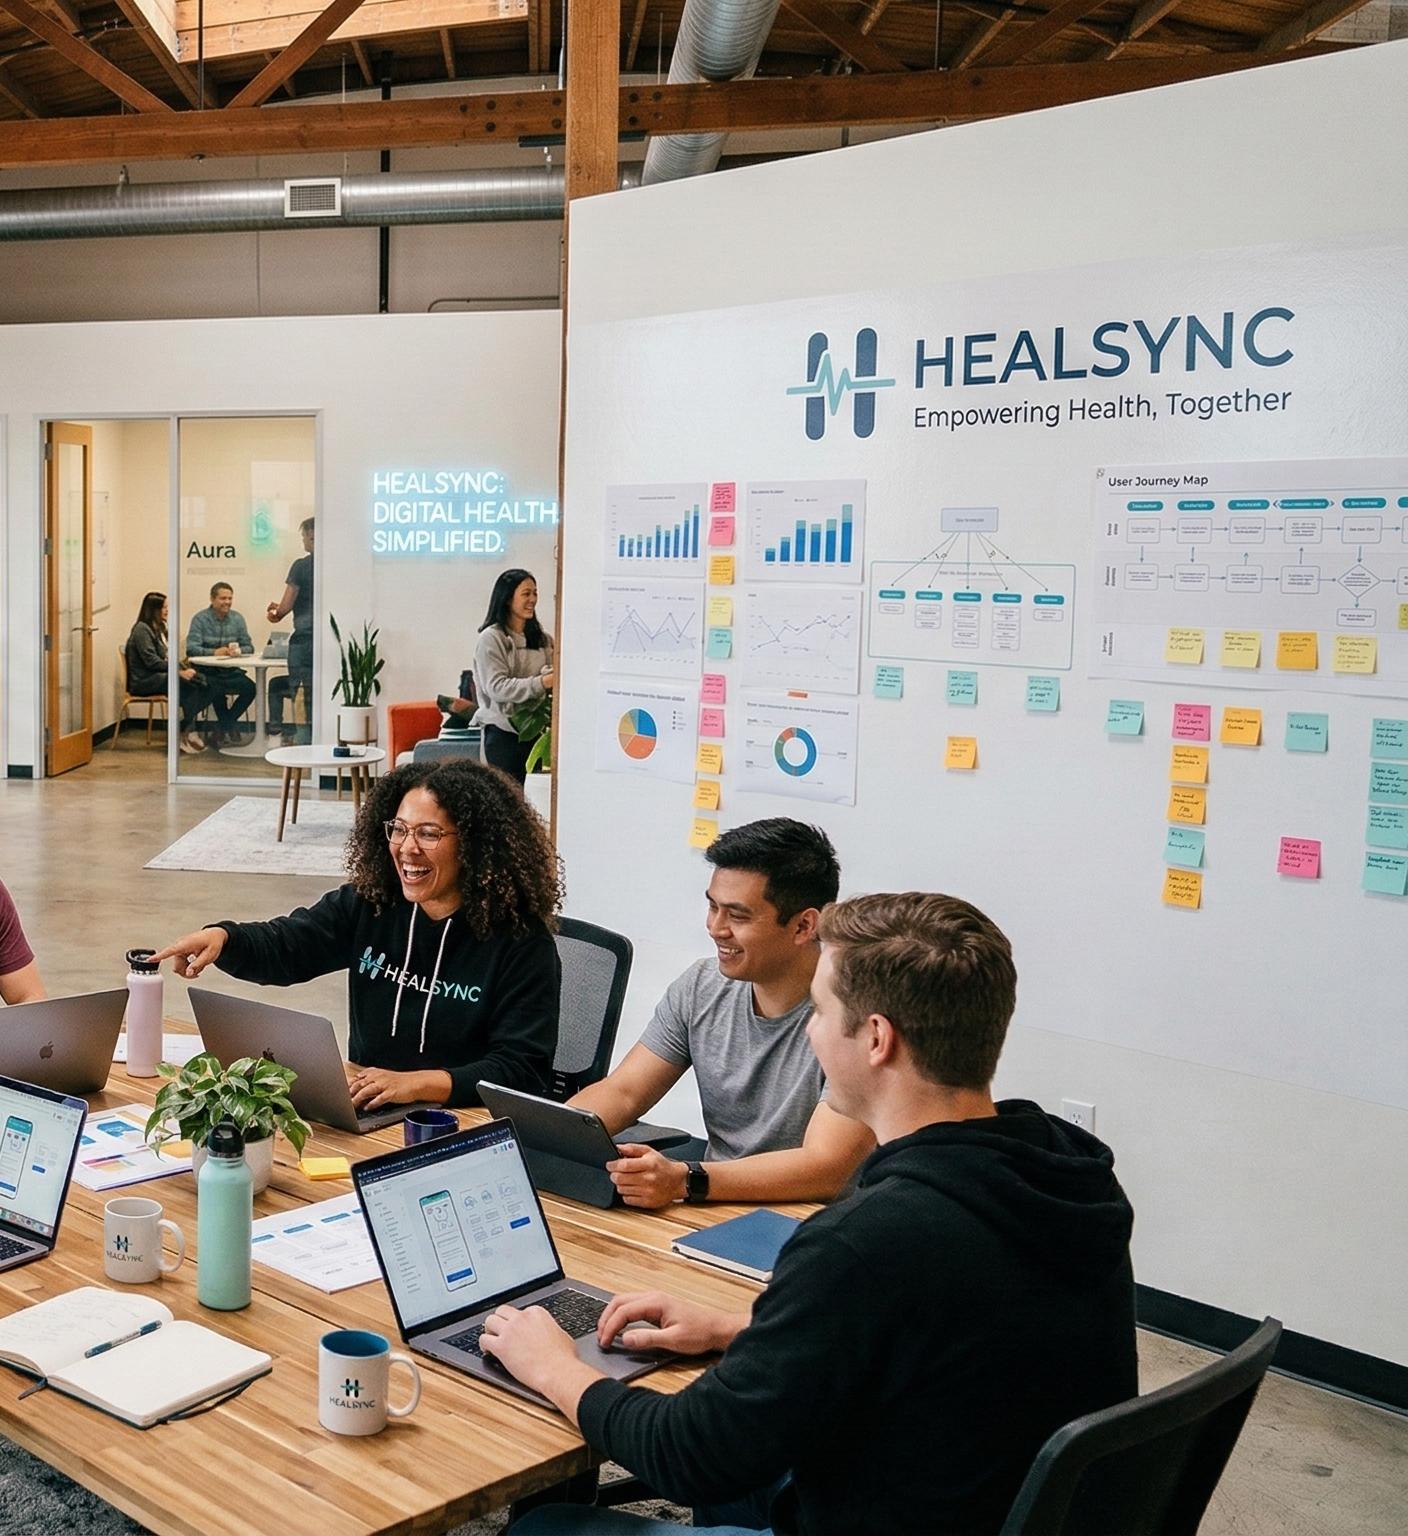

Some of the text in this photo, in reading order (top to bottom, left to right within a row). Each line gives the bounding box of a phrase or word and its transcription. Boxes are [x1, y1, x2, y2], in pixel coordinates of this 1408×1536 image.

[914, 306, 1295, 389] HEALSYNC
[914, 387, 1292, 432] Empowering Health, Together
[373, 471, 504, 494] HEALSYNC:
[1108, 474, 1209, 488] User Journey Map
[374, 501, 462, 524] DIGITAL
[187, 541, 236, 558] Aura
[372, 529, 504, 553] SIMPLIFIED.
[384, 964, 481, 1003] HEALSYNC
